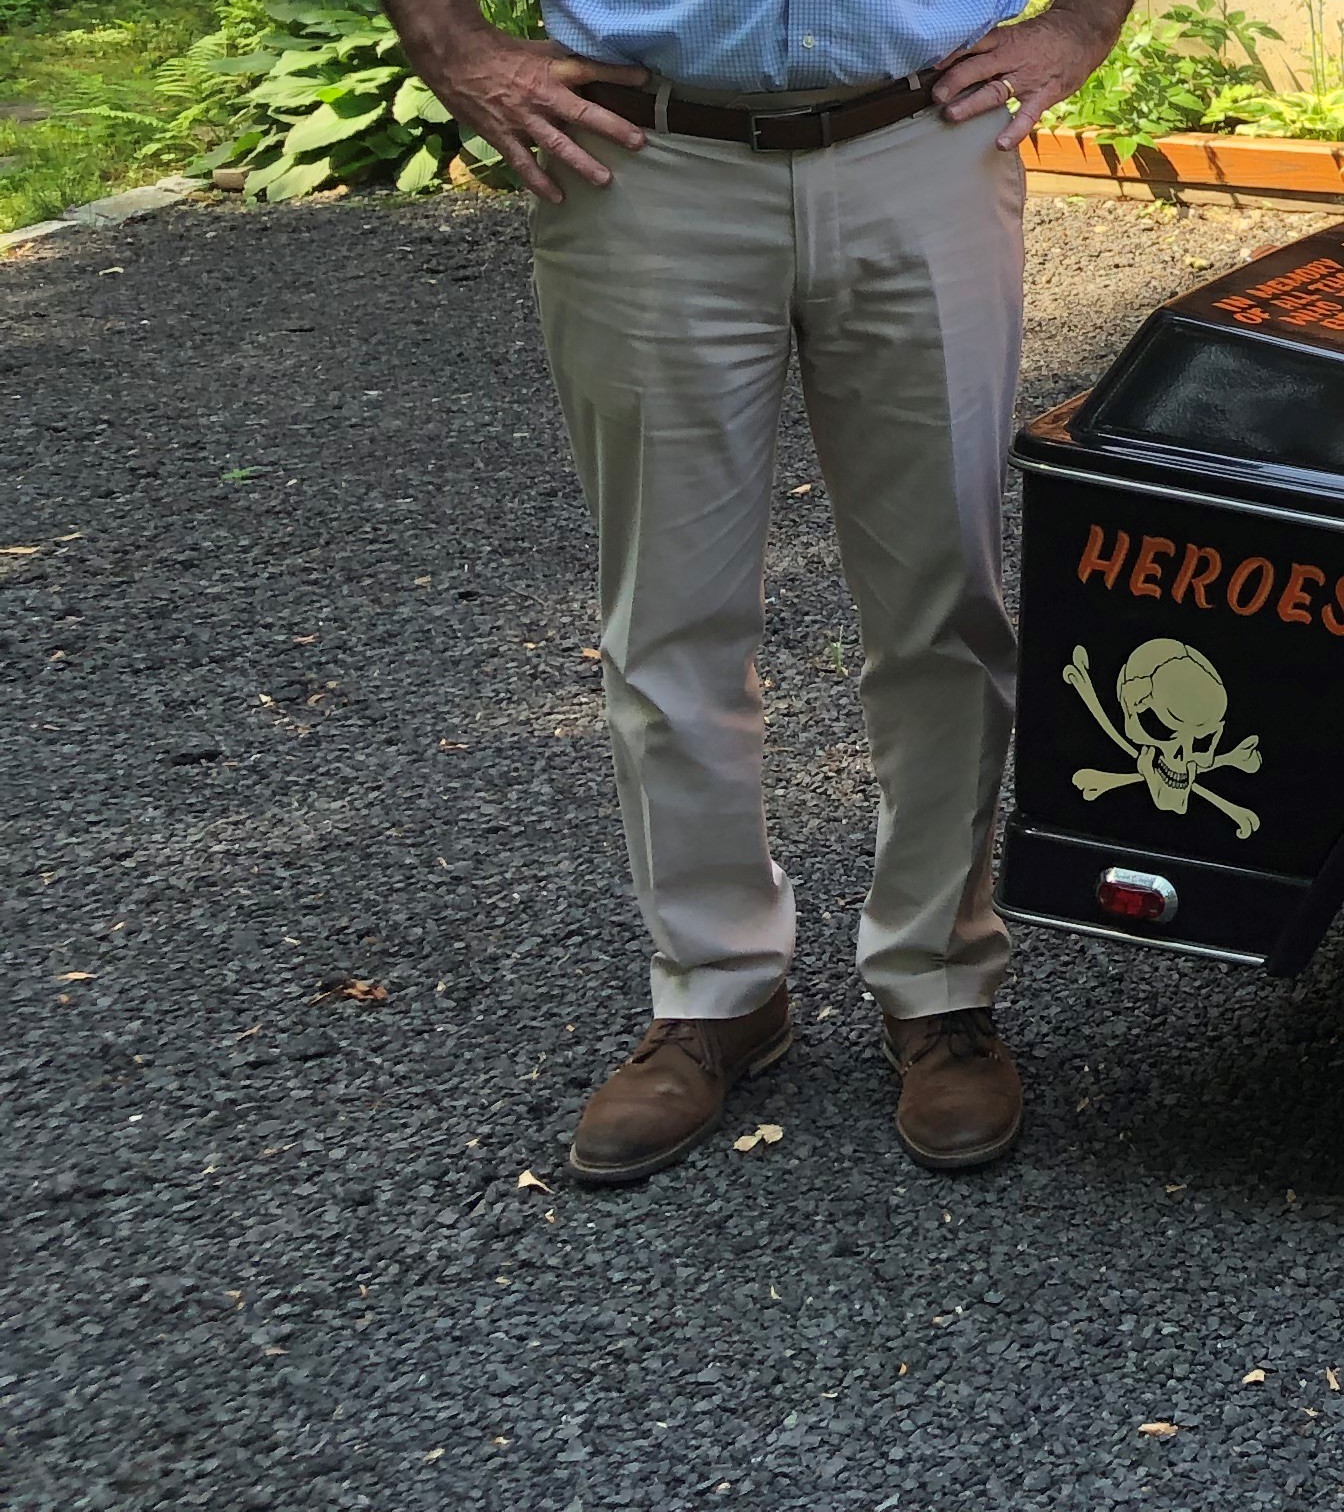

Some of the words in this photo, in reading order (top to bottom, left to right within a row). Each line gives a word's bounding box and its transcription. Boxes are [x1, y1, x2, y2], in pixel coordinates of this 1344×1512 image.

[1212, 296, 1257, 311] IN
[1245, 258, 1344, 298] MEMORY
[1233, 307, 1271, 324] OF
[1269, 292, 1322, 309] ALL
[1278, 301, 1342, 325] WHO
